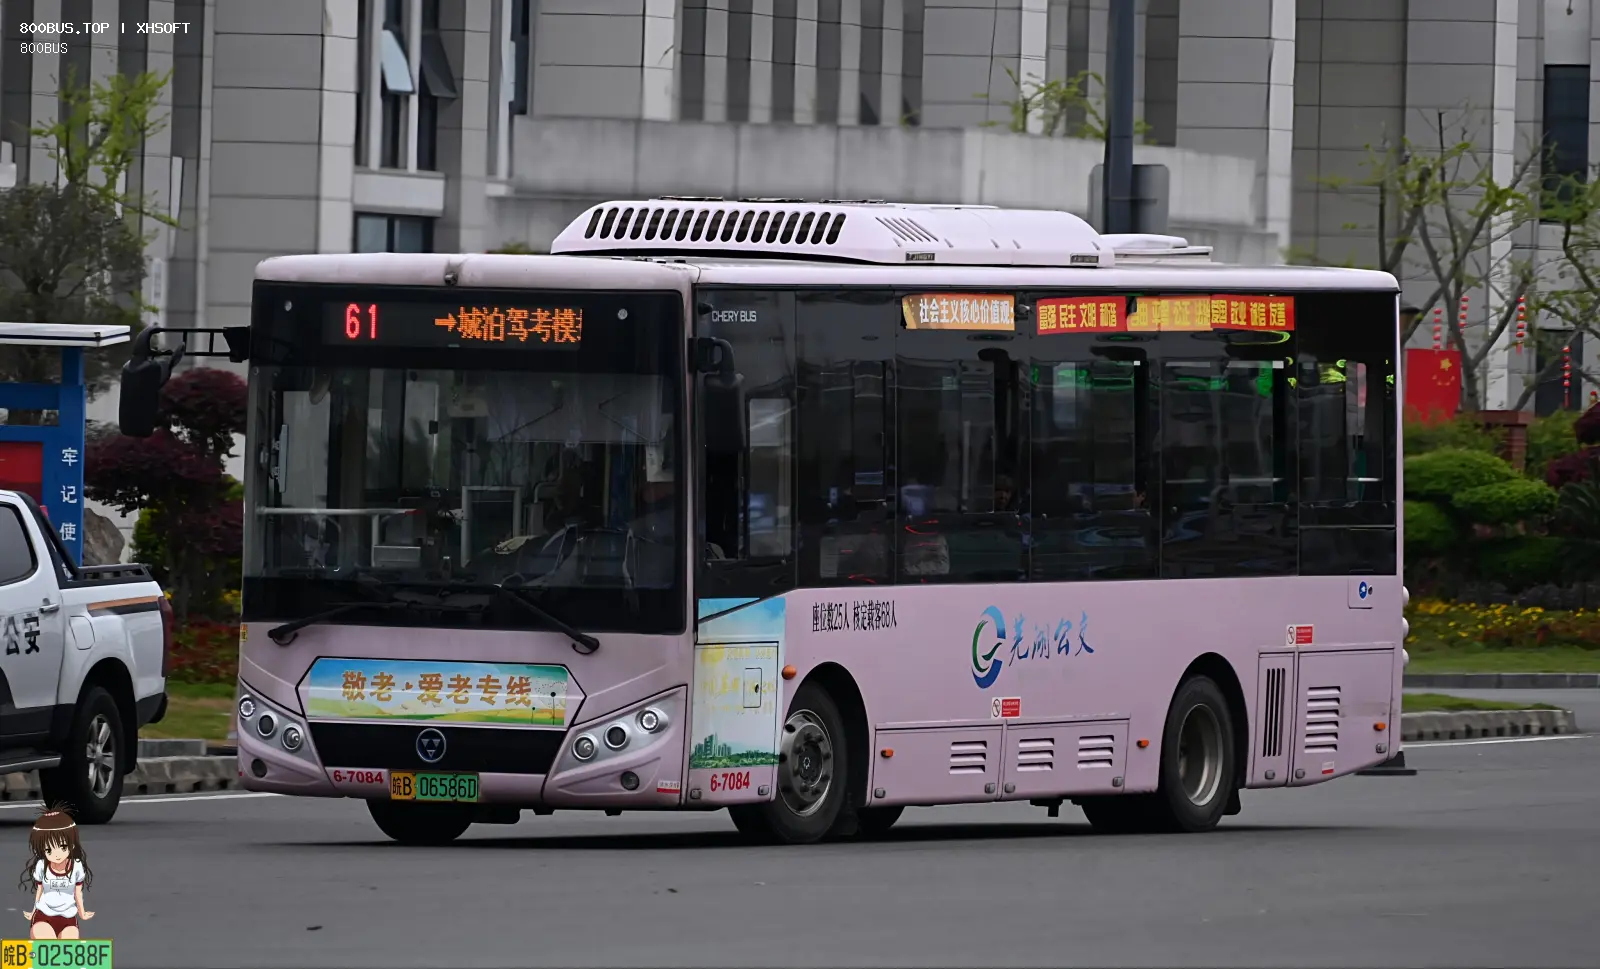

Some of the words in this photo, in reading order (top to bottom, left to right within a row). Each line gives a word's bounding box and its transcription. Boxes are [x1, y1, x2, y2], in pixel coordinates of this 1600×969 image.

[344, 303, 378, 340] 61
[711, 310, 739, 323] CHERY
[740, 310, 758, 322] BUS
[1038, 304, 1057, 330] 富强
[1059, 303, 1077, 329] 民主
[1079, 302, 1097, 328] 文明
[1249, 301, 1267, 327] 诚信
[1269, 302, 1287, 327] 友善
[812, 601, 850, 633] 座位数25人
[853, 599, 898, 632] 核定载客68人
[3, 612, 41, 656] 公安
[341, 669, 397, 702] 敬老
[416, 672, 533, 708] 爱老专线
[333, 769, 384, 785] 6-7084
[710, 771, 750, 792] 6-7084
